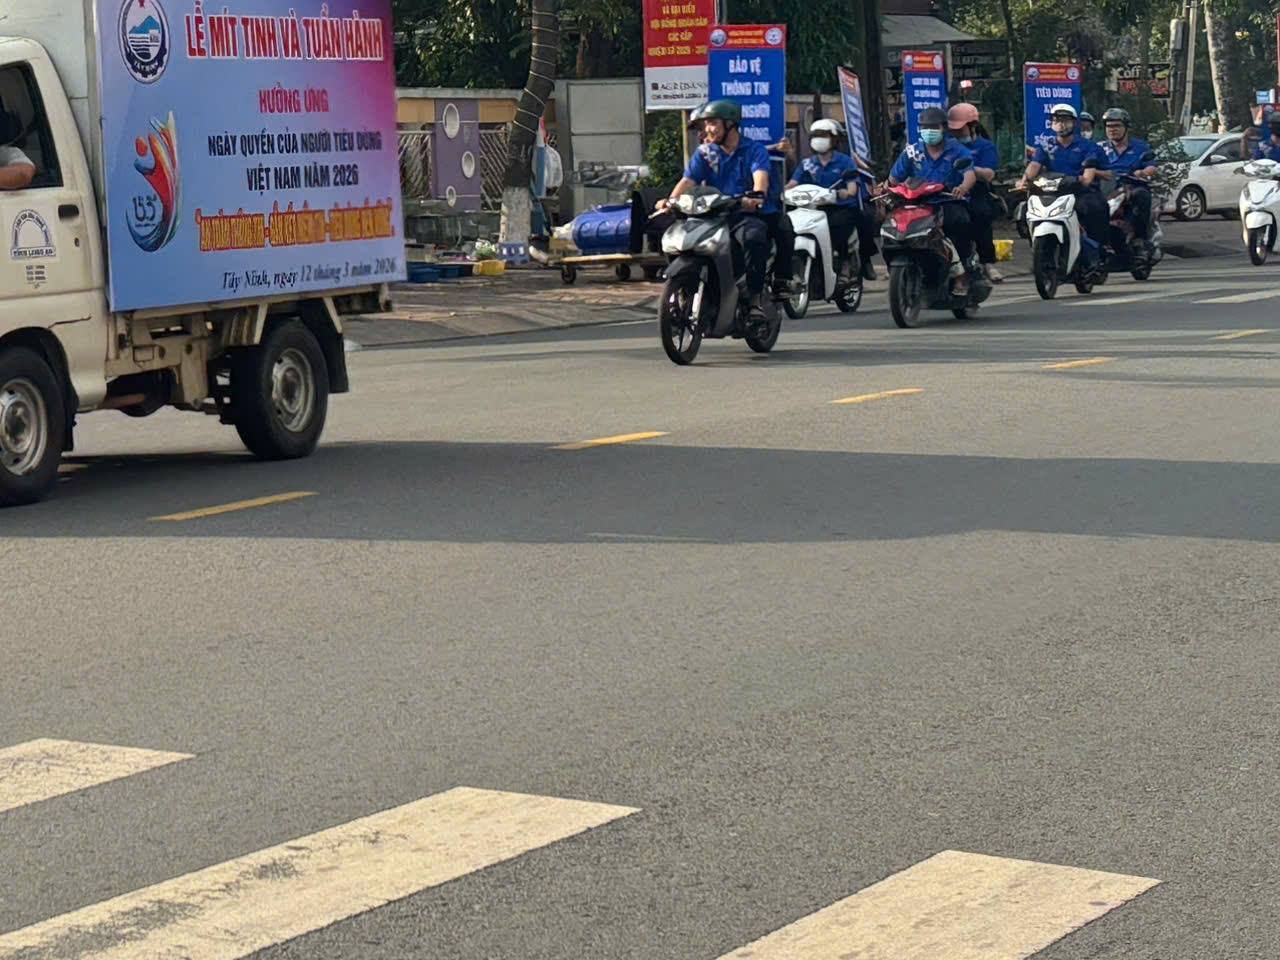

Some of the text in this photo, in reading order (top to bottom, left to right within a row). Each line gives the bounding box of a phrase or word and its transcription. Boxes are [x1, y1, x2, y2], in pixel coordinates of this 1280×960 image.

[185, 0, 208, 59] LỄ
[207, 6, 238, 58] MÍT
[240, 15, 279, 60] TINH
[279, 7, 303, 60] VÀ
[342, 9, 384, 61] HÀNH
[728, 55, 762, 76] BẢO VỆ
[721, 79, 770, 97] THÔNG TIN
[208, 130, 237, 156] NGÀY
[240, 127, 275, 157] QUYỀN
[277, 126, 299, 154] CỦA
[246, 161, 359, 196] VIỆT NAM NĂM 2026
[300, 265, 312, 282] 12
